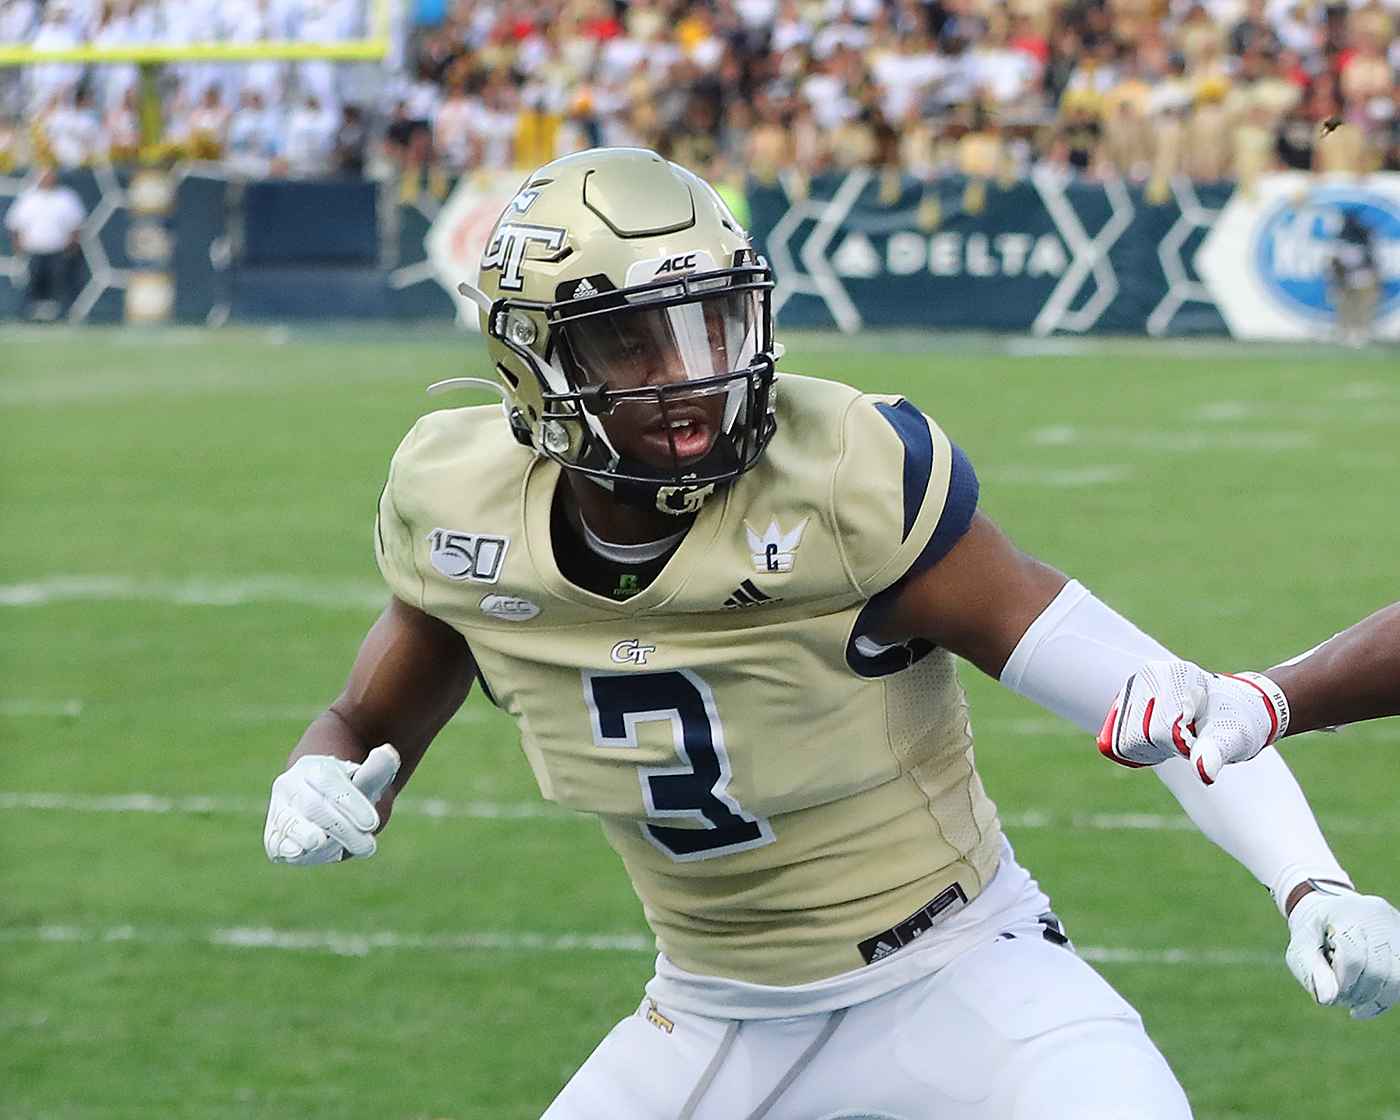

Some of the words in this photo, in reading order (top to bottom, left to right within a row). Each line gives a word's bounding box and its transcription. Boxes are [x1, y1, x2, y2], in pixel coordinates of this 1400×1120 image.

[655, 254, 697, 275] ACC
[886, 230, 1070, 278] DELTA
[430, 531, 506, 581] 150
[490, 601, 531, 615] ACC
[610, 639, 655, 665] GT
[581, 668, 777, 863] 3
